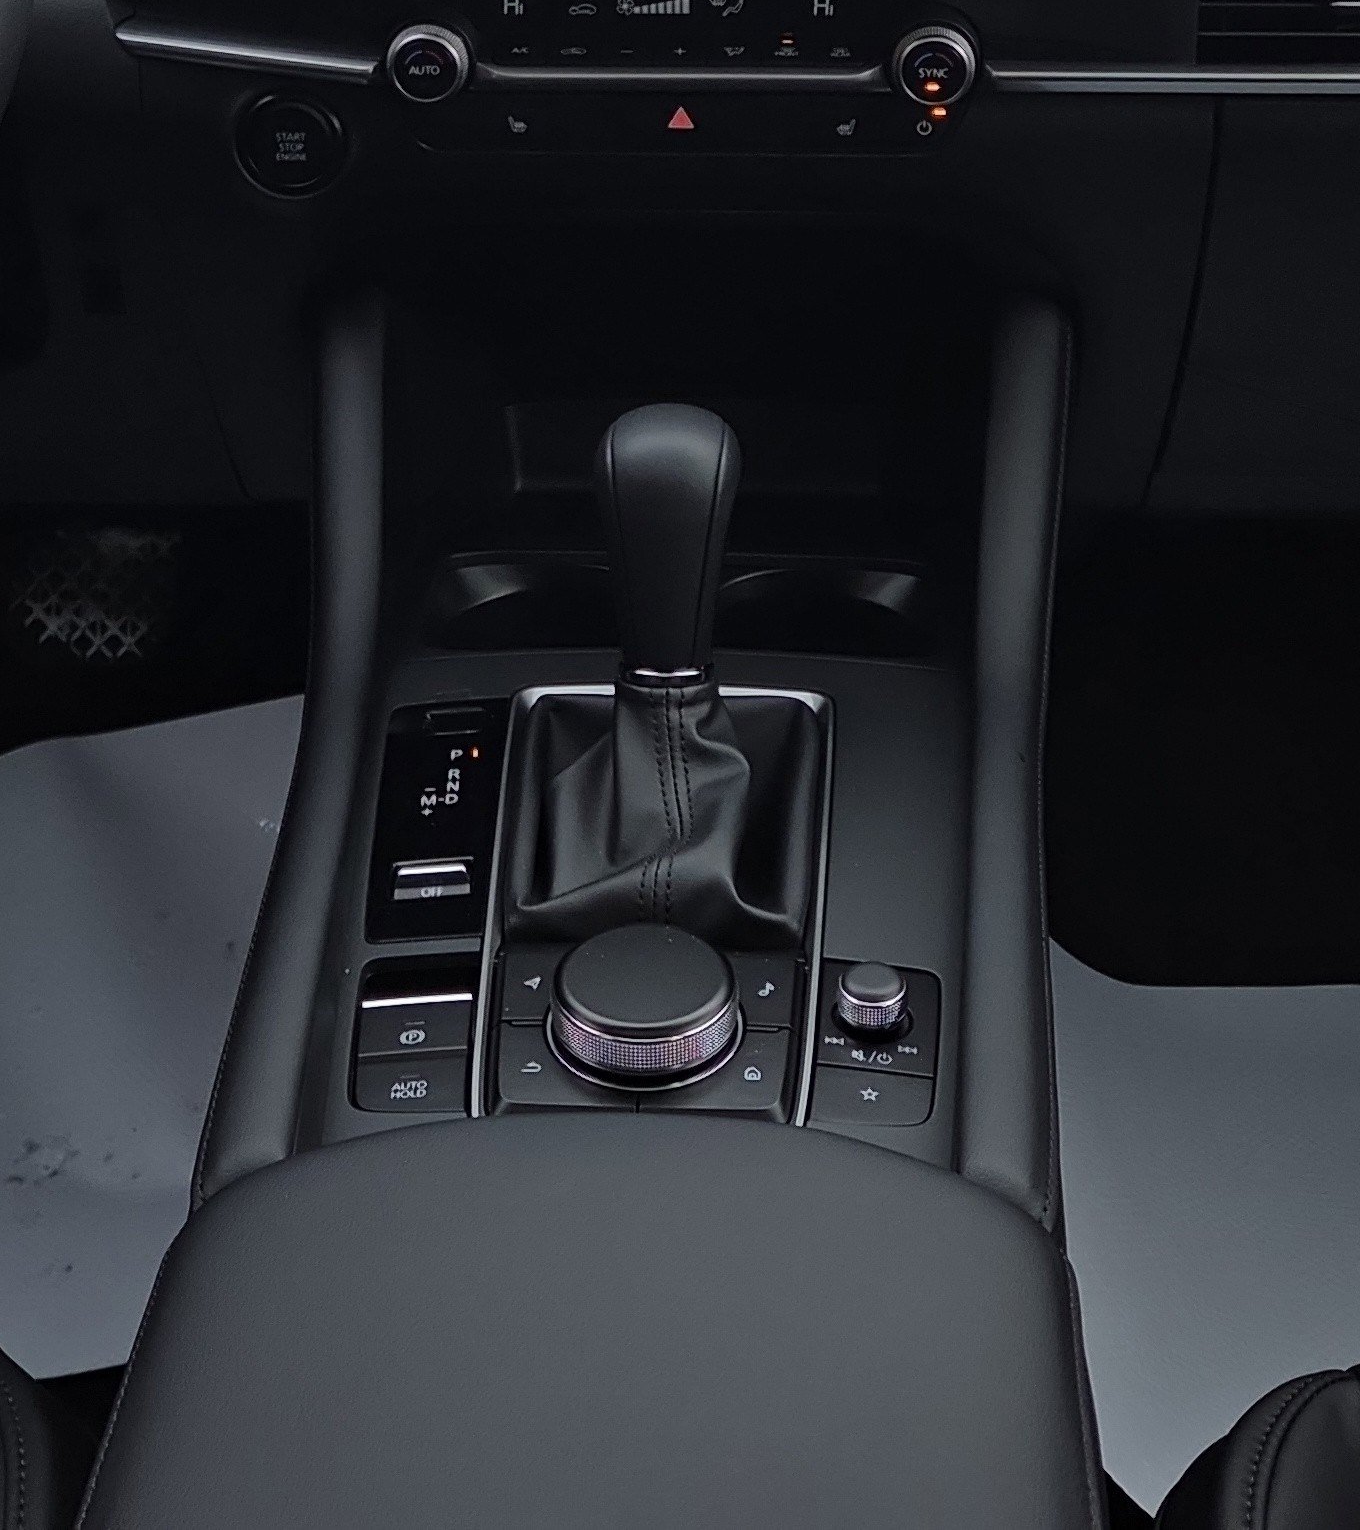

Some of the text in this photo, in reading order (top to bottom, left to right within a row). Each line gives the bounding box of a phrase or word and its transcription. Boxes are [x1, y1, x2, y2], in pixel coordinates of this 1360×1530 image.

[408, 65, 441, 76] AUTO
[918, 67, 949, 79] SYNC
[275, 131, 307, 142] START
[278, 142, 305, 152] STOP
[275, 152, 308, 161] ENGINE
[450, 749, 464, 761] P
[447, 768, 461, 780] R
[446, 780, 460, 792] N
[421, 886, 443, 898] OFF
[390, 1080, 429, 1090] AUTO
[390, 1089, 428, 1099] HOLD
